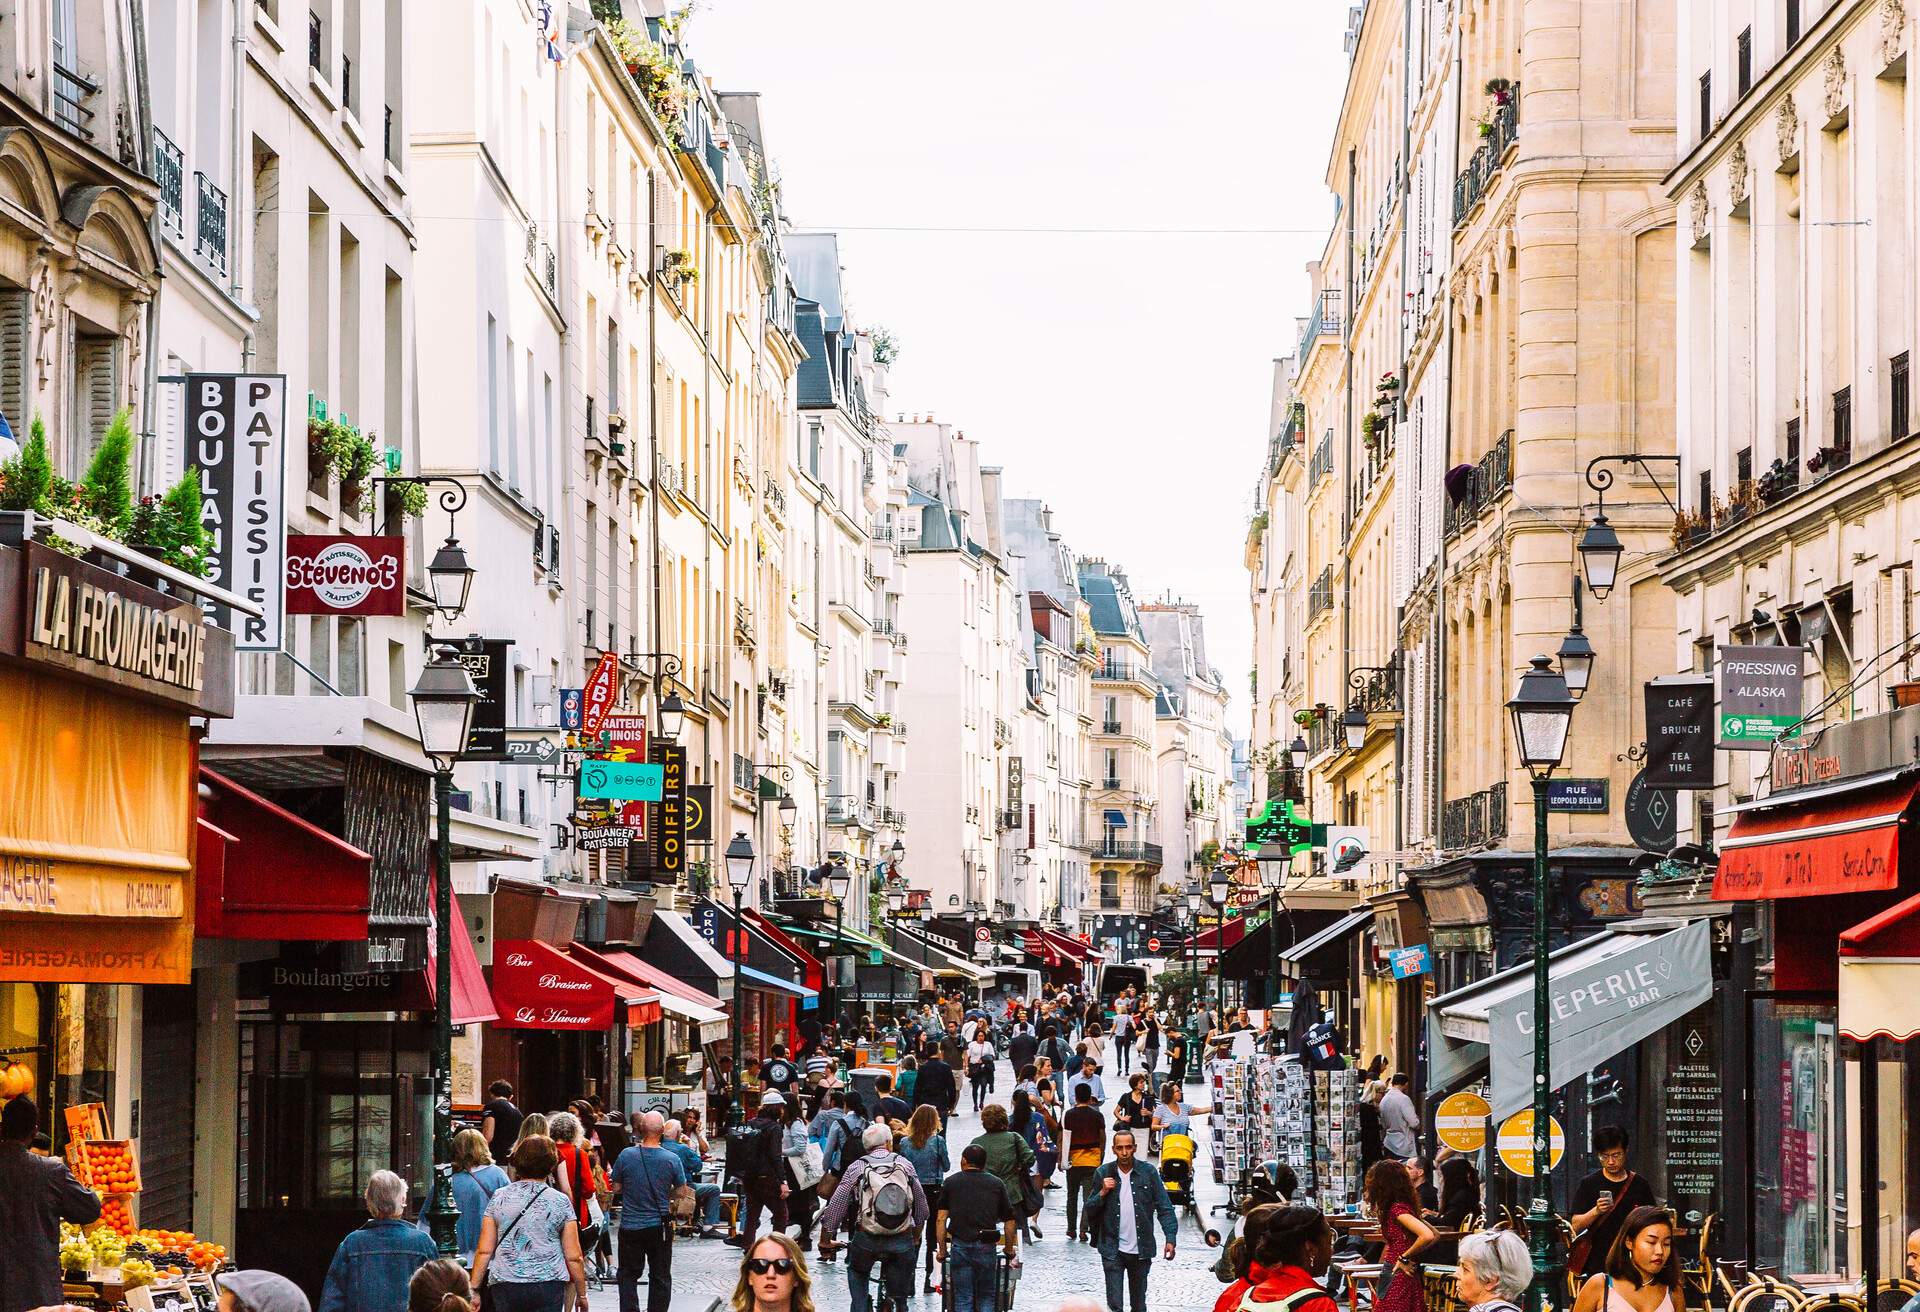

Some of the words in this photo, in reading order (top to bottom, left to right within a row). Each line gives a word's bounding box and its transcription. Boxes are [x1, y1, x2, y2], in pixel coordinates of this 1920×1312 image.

[287, 557, 395, 589] Stévenot
[325, 590, 362, 602] TRAITEUR
[34, 567, 70, 651] LA
[73, 582, 207, 692] FROMAGERIE
[1726, 662, 1797, 676] PRESSING
[587, 660, 613, 728] TABAC
[1737, 686, 1786, 698] ALASKA
[1668, 696, 1693, 708] CAFÉ
[601, 718, 645, 729] RAITEUR
[1661, 725, 1701, 735] BRUNCH
[508, 743, 532, 754] FDJ
[1671, 752, 1690, 761] TEA
[1668, 763, 1693, 772] TIME
[1010, 760, 1020, 825] HÔTEL
[1566, 786, 1587, 794] RUE
[1551, 796, 1577, 804] LEOPOLD
[1578, 796, 1602, 804] BELLAN
[629, 814, 641, 825] DE
[582, 827, 635, 840] BOULANGER
[584, 838, 630, 850] PATISSIER
[1241, 893, 1259, 903] BAR
[703, 910, 715, 945] GROM
[506, 953, 534, 967] Bar
[274, 967, 391, 991] Boulangerie
[539, 973, 593, 991] Brasserie
[1515, 961, 1656, 1035] CÊPERIE
[1626, 986, 1661, 1009] BAR
[514, 1007, 536, 1023] Le
[541, 1007, 592, 1024] Havane
[1306, 1031, 1332, 1047] FRANCE
[1691, 1037, 1698, 1048] C
[1667, 1085, 1691, 1093] CRÊPES
[1666, 1129, 1689, 1137] BIÈRES
